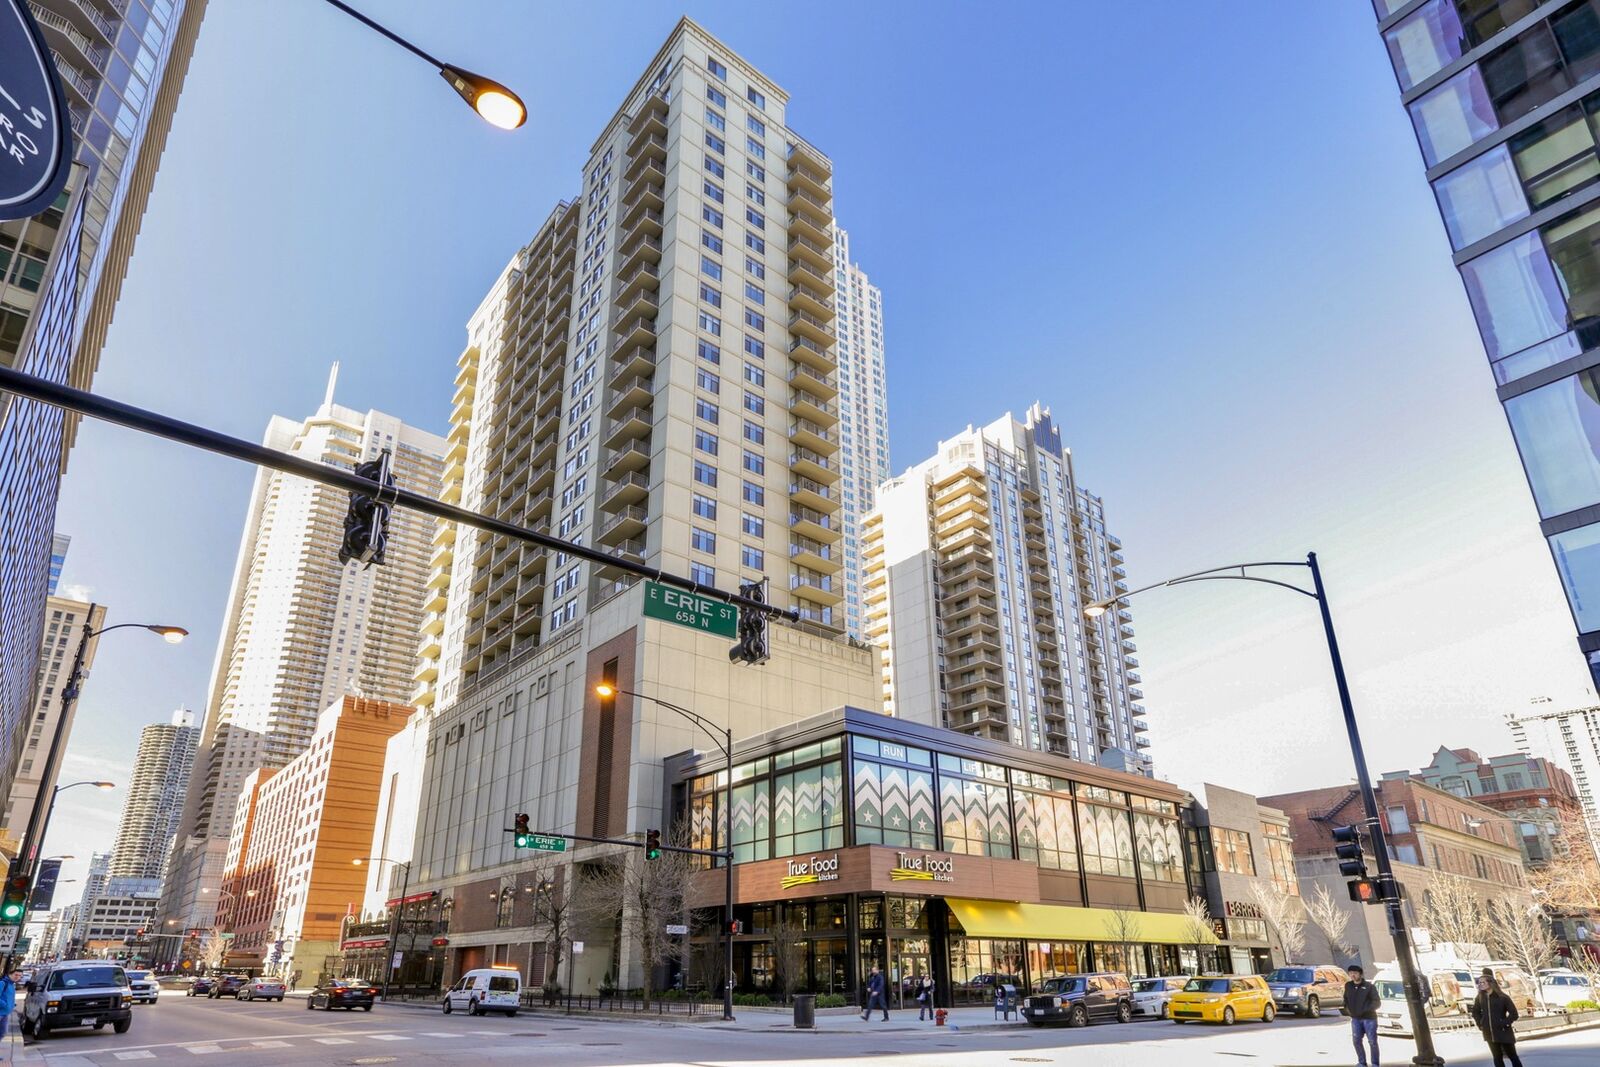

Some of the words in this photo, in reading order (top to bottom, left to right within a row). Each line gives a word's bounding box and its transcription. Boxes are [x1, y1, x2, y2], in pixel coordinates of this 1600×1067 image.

[650, 588, 657, 599] E
[664, 590, 713, 617] ERIE
[720, 608, 732, 620] ST
[675, 612, 696, 624] 658
[701, 617, 709, 628] N
[883, 745, 903, 757] RUN
[963, 761, 978, 773] LIF
[535, 837, 556, 845] ERIE
[786, 859, 807, 877] True
[810, 853, 838, 873] Food
[897, 851, 922, 870] True
[925, 854, 953, 873] Food
[818, 873, 839, 882] kitchen
[934, 873, 954, 882] kitchen
[0, 927, 15, 935] NE
